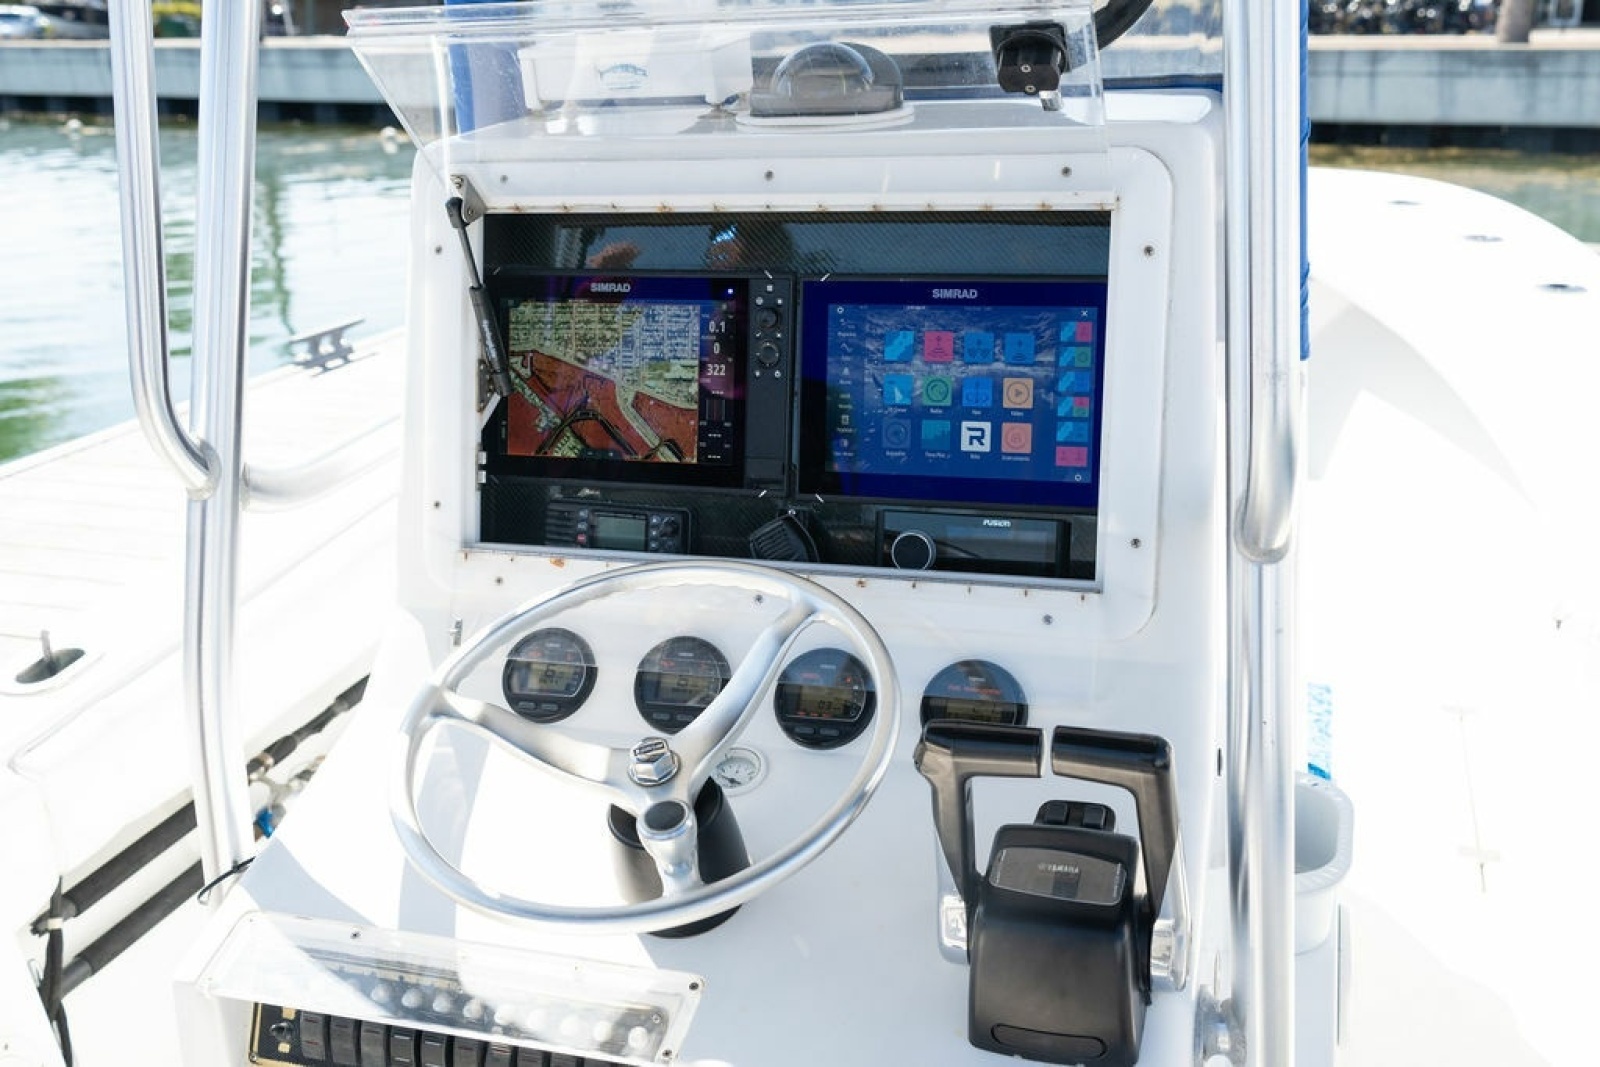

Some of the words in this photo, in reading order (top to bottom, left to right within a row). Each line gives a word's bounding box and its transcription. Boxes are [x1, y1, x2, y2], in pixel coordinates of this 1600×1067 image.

[590, 282, 631, 293] SIMRAD
[932, 288, 978, 299] SIMRAD
[709, 320, 726, 333] 0.1
[713, 342, 720, 354] 0
[706, 363, 726, 376] 322
